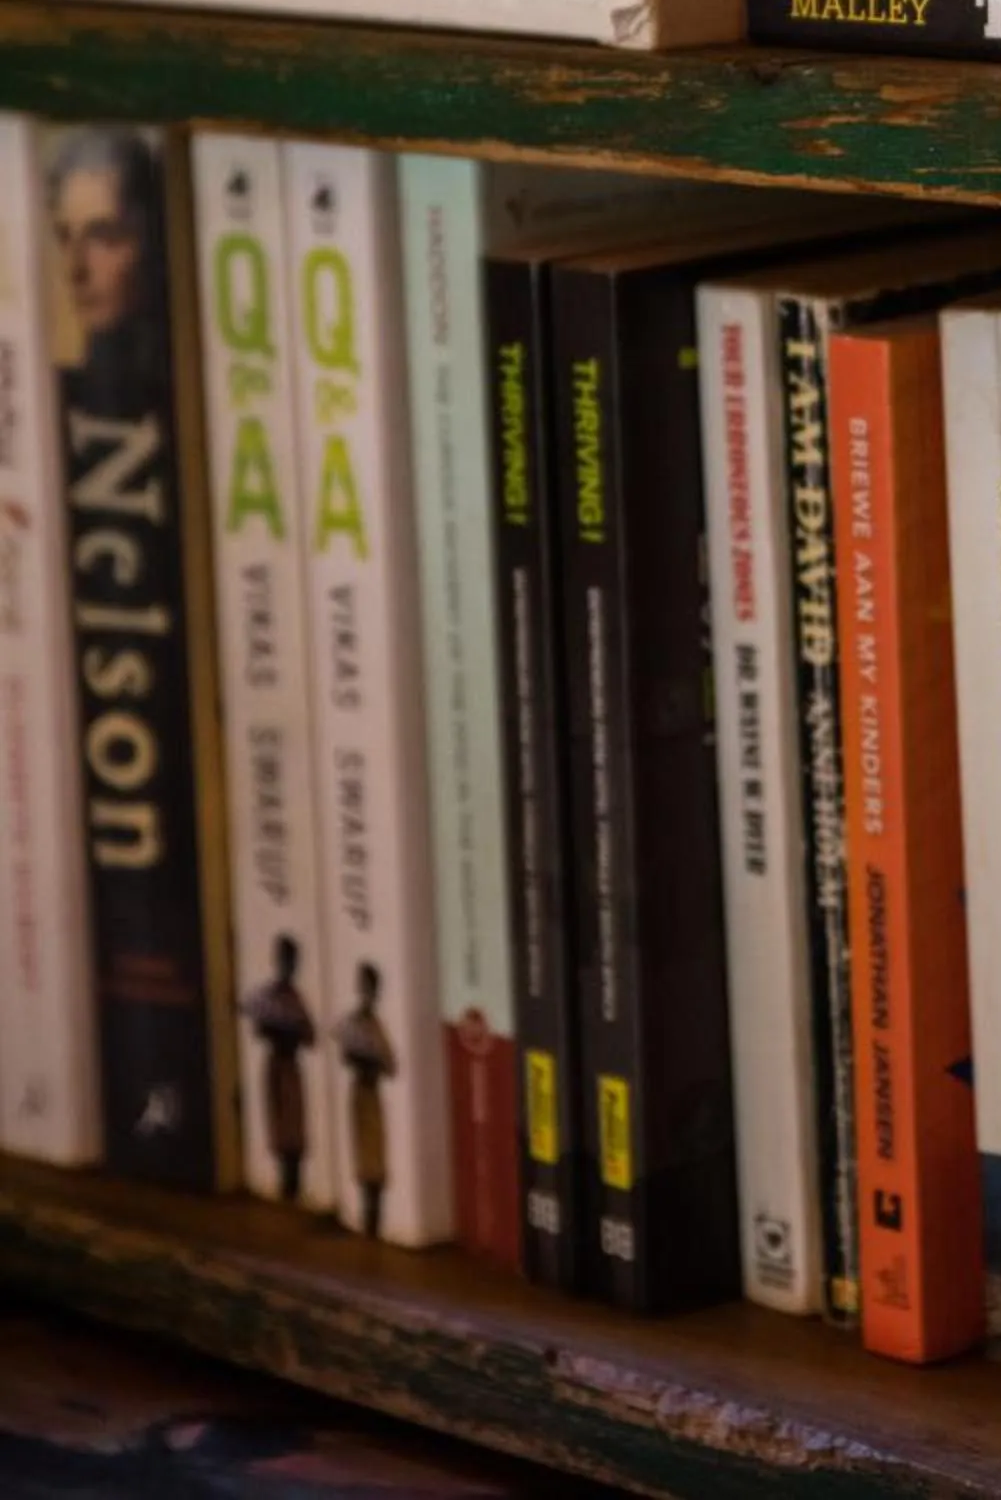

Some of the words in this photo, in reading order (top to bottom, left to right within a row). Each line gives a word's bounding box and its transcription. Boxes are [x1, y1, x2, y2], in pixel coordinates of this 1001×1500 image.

[786, 338, 816, 356] I
[788, 372, 825, 468] AM
[848, 418, 872, 538] BRIEWE
[242, 564, 279, 690] VIKAS
[792, 483, 834, 666] DAVID
[853, 552, 875, 622] AAN
[66, 410, 170, 870] Nelson
[329, 585, 364, 711] VIKAS
[855, 634, 877, 682] MY
[246, 726, 286, 907] SWARUP
[858, 695, 884, 838] KINDERS
[333, 749, 371, 931] SWARUP
[864, 864, 891, 1030] JONATHAN
[871, 1039, 896, 1161] JANSEN
